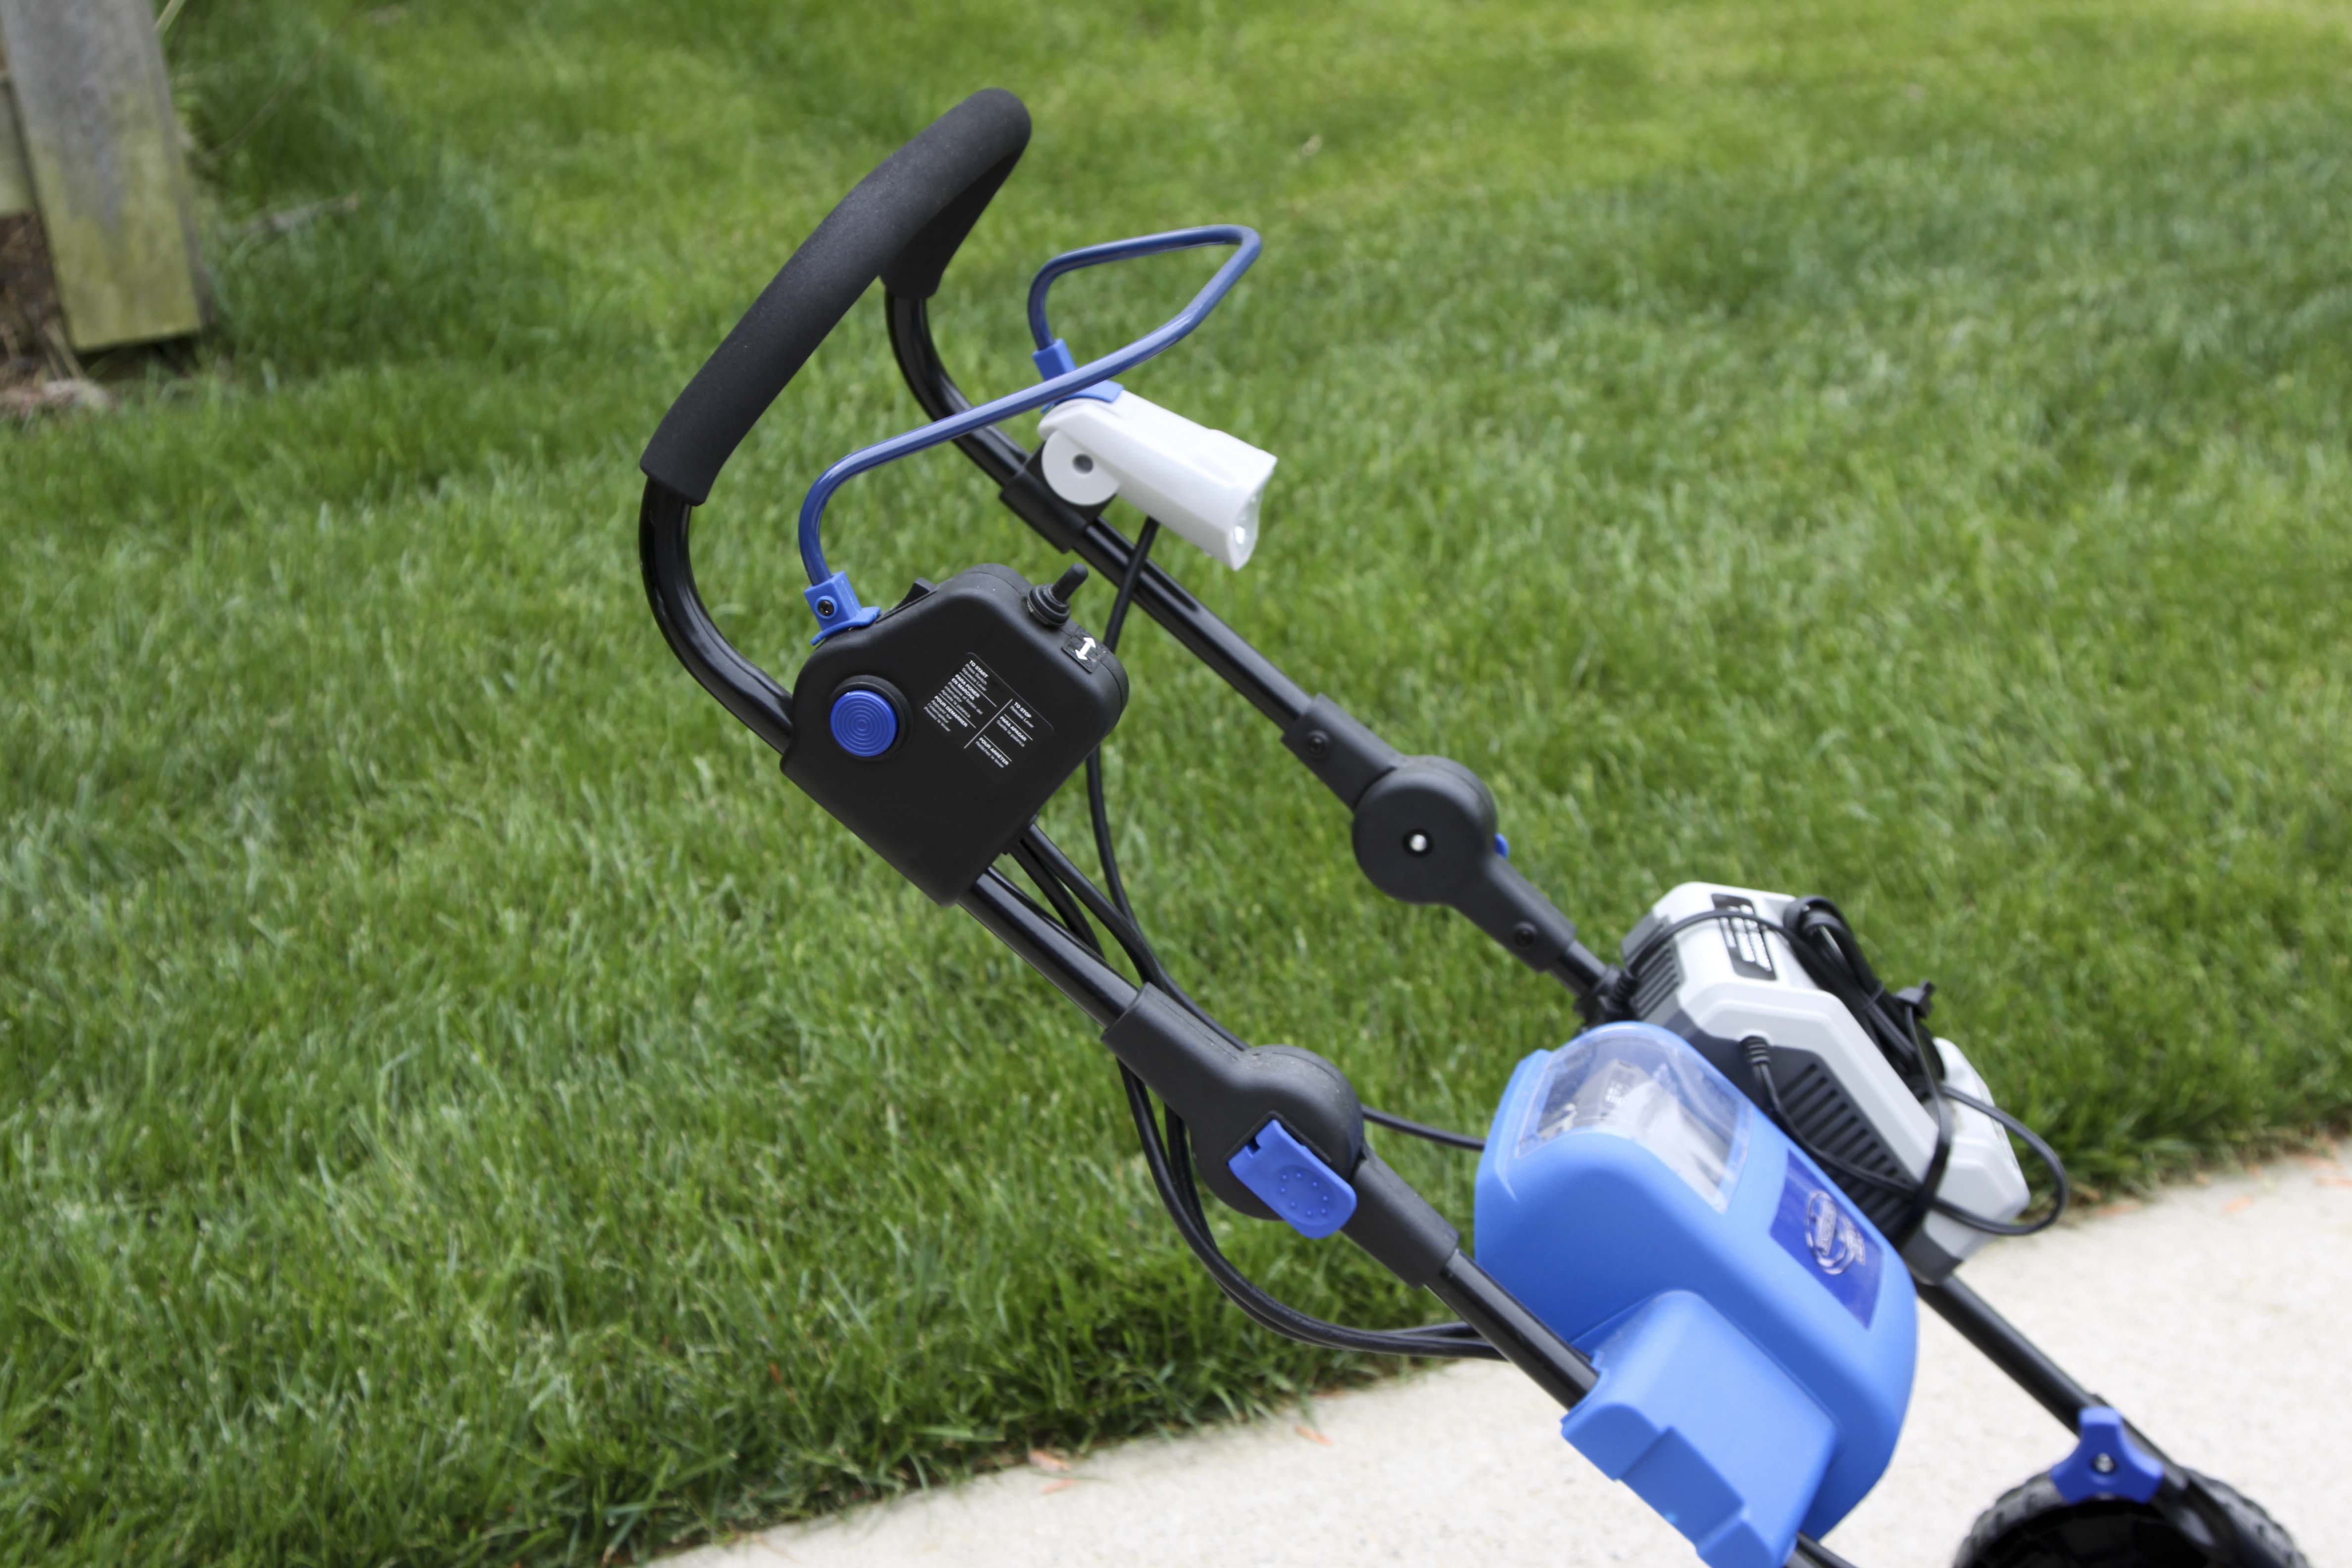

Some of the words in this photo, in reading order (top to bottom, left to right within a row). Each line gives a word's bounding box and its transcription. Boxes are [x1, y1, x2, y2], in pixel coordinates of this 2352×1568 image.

[974, 665, 988, 678] START
[954, 674, 967, 685] PARA
[965, 684, 980, 698] PONER
[957, 683, 975, 700] MARCHA
[934, 695, 947, 707] POUR
[1019, 707, 1031, 719] STOP
[999, 715, 1011, 727] PARA
[1010, 725, 1027, 741] APAGAR
[979, 736, 991, 749] POUR
